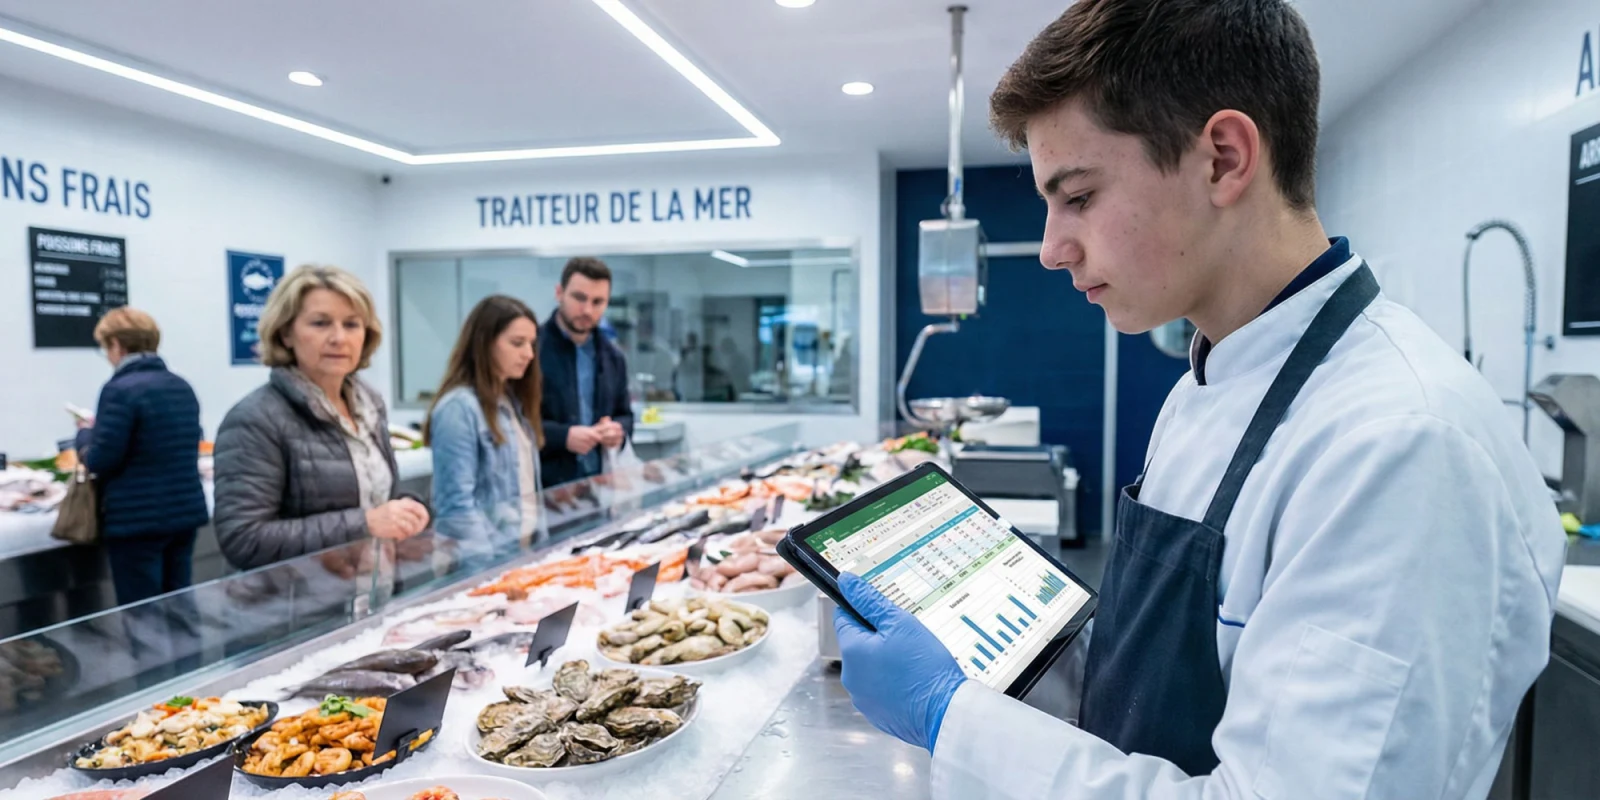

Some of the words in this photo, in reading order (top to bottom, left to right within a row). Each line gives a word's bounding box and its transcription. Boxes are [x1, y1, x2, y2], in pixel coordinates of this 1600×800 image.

[1575, 24, 1600, 97] A
[62, 166, 151, 219] FRAIS
[476, 193, 600, 228] TRAITEUR
[609, 191, 642, 223] DE
[651, 189, 684, 222] LA
[695, 186, 752, 221] MER
